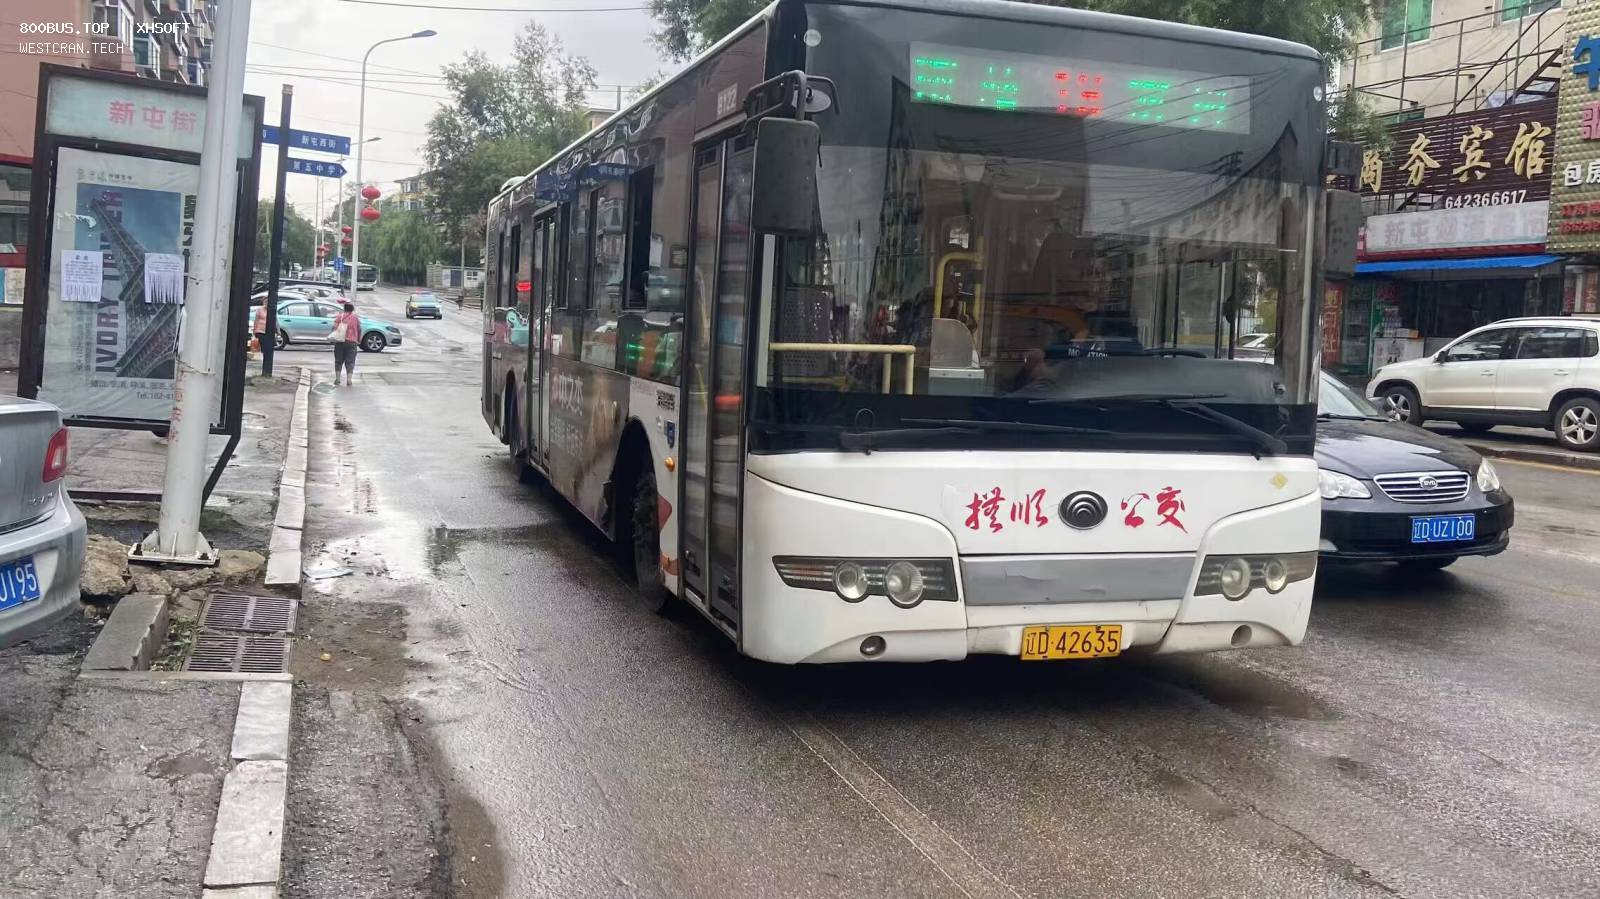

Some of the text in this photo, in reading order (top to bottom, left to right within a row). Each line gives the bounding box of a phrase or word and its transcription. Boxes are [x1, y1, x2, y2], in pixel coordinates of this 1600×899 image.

[109, 100, 197, 134] 新屯街
[1359, 121, 1552, 193] 商务宾馆
[1445, 190, 1527, 210] 642366617
[96, 296, 119, 373] IVORY
